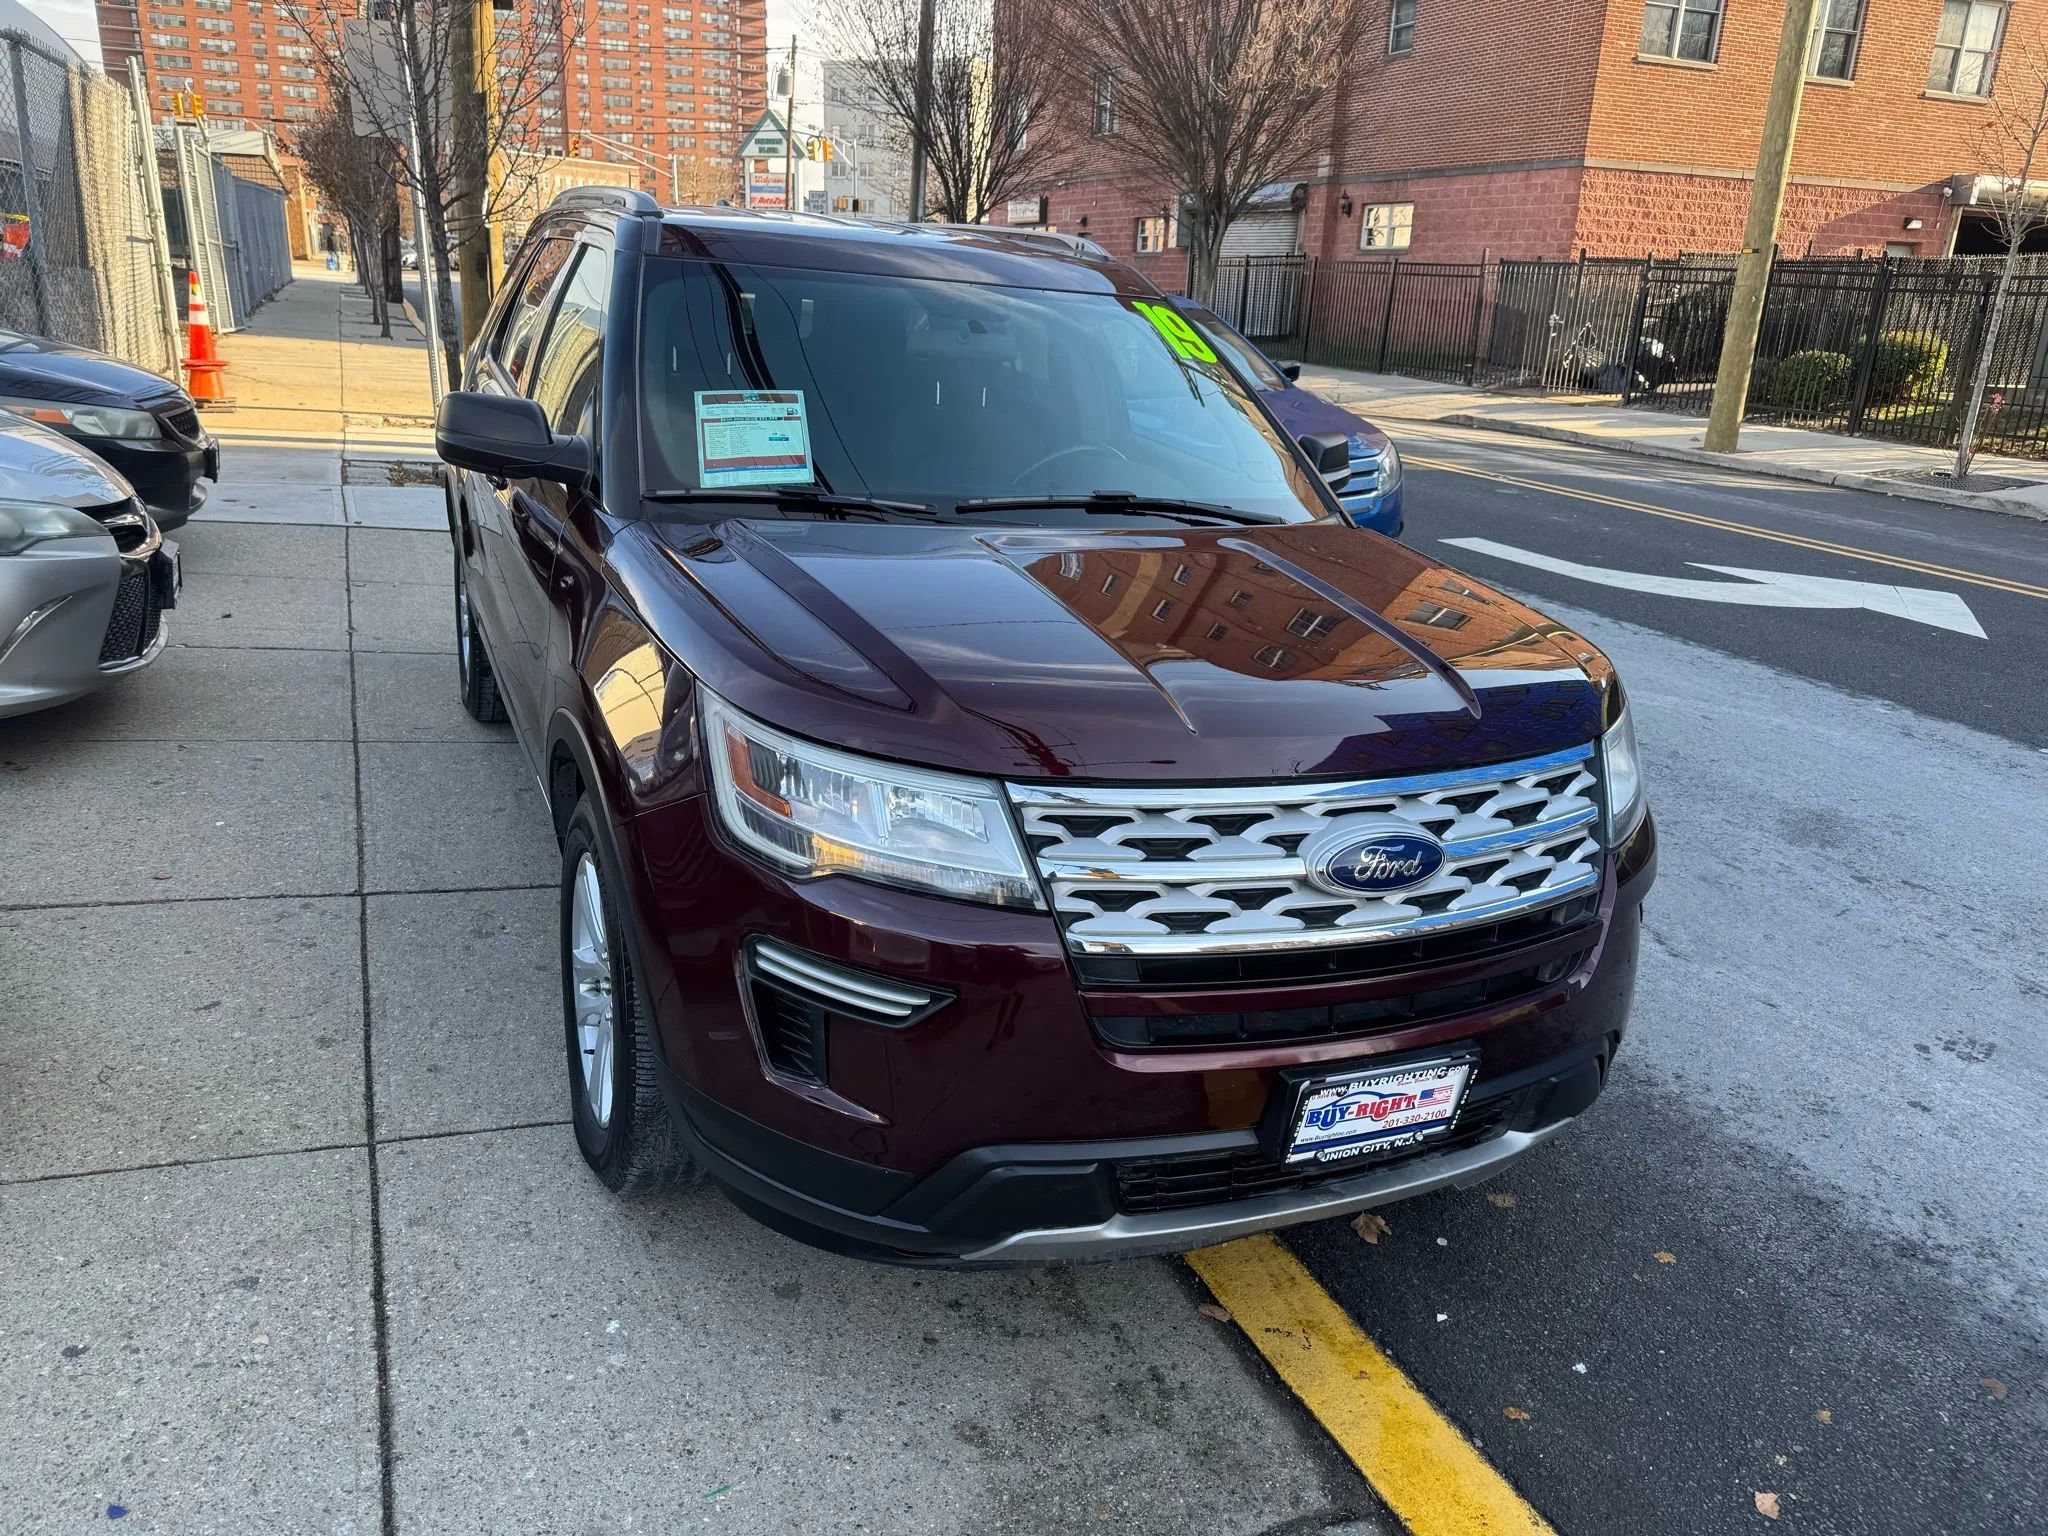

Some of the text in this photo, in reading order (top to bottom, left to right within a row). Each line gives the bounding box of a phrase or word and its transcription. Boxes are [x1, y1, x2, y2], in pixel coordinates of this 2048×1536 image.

[758, 196, 785, 205] AutoZo
[1131, 301, 1217, 363] 19
[1354, 844, 1423, 882] Ford
[1307, 1094, 1417, 1128] BUY-RIGHT
[1382, 1109, 1447, 1128] 201-330-2100
[1320, 1137, 1415, 1162] UNION CITY, N.J.
